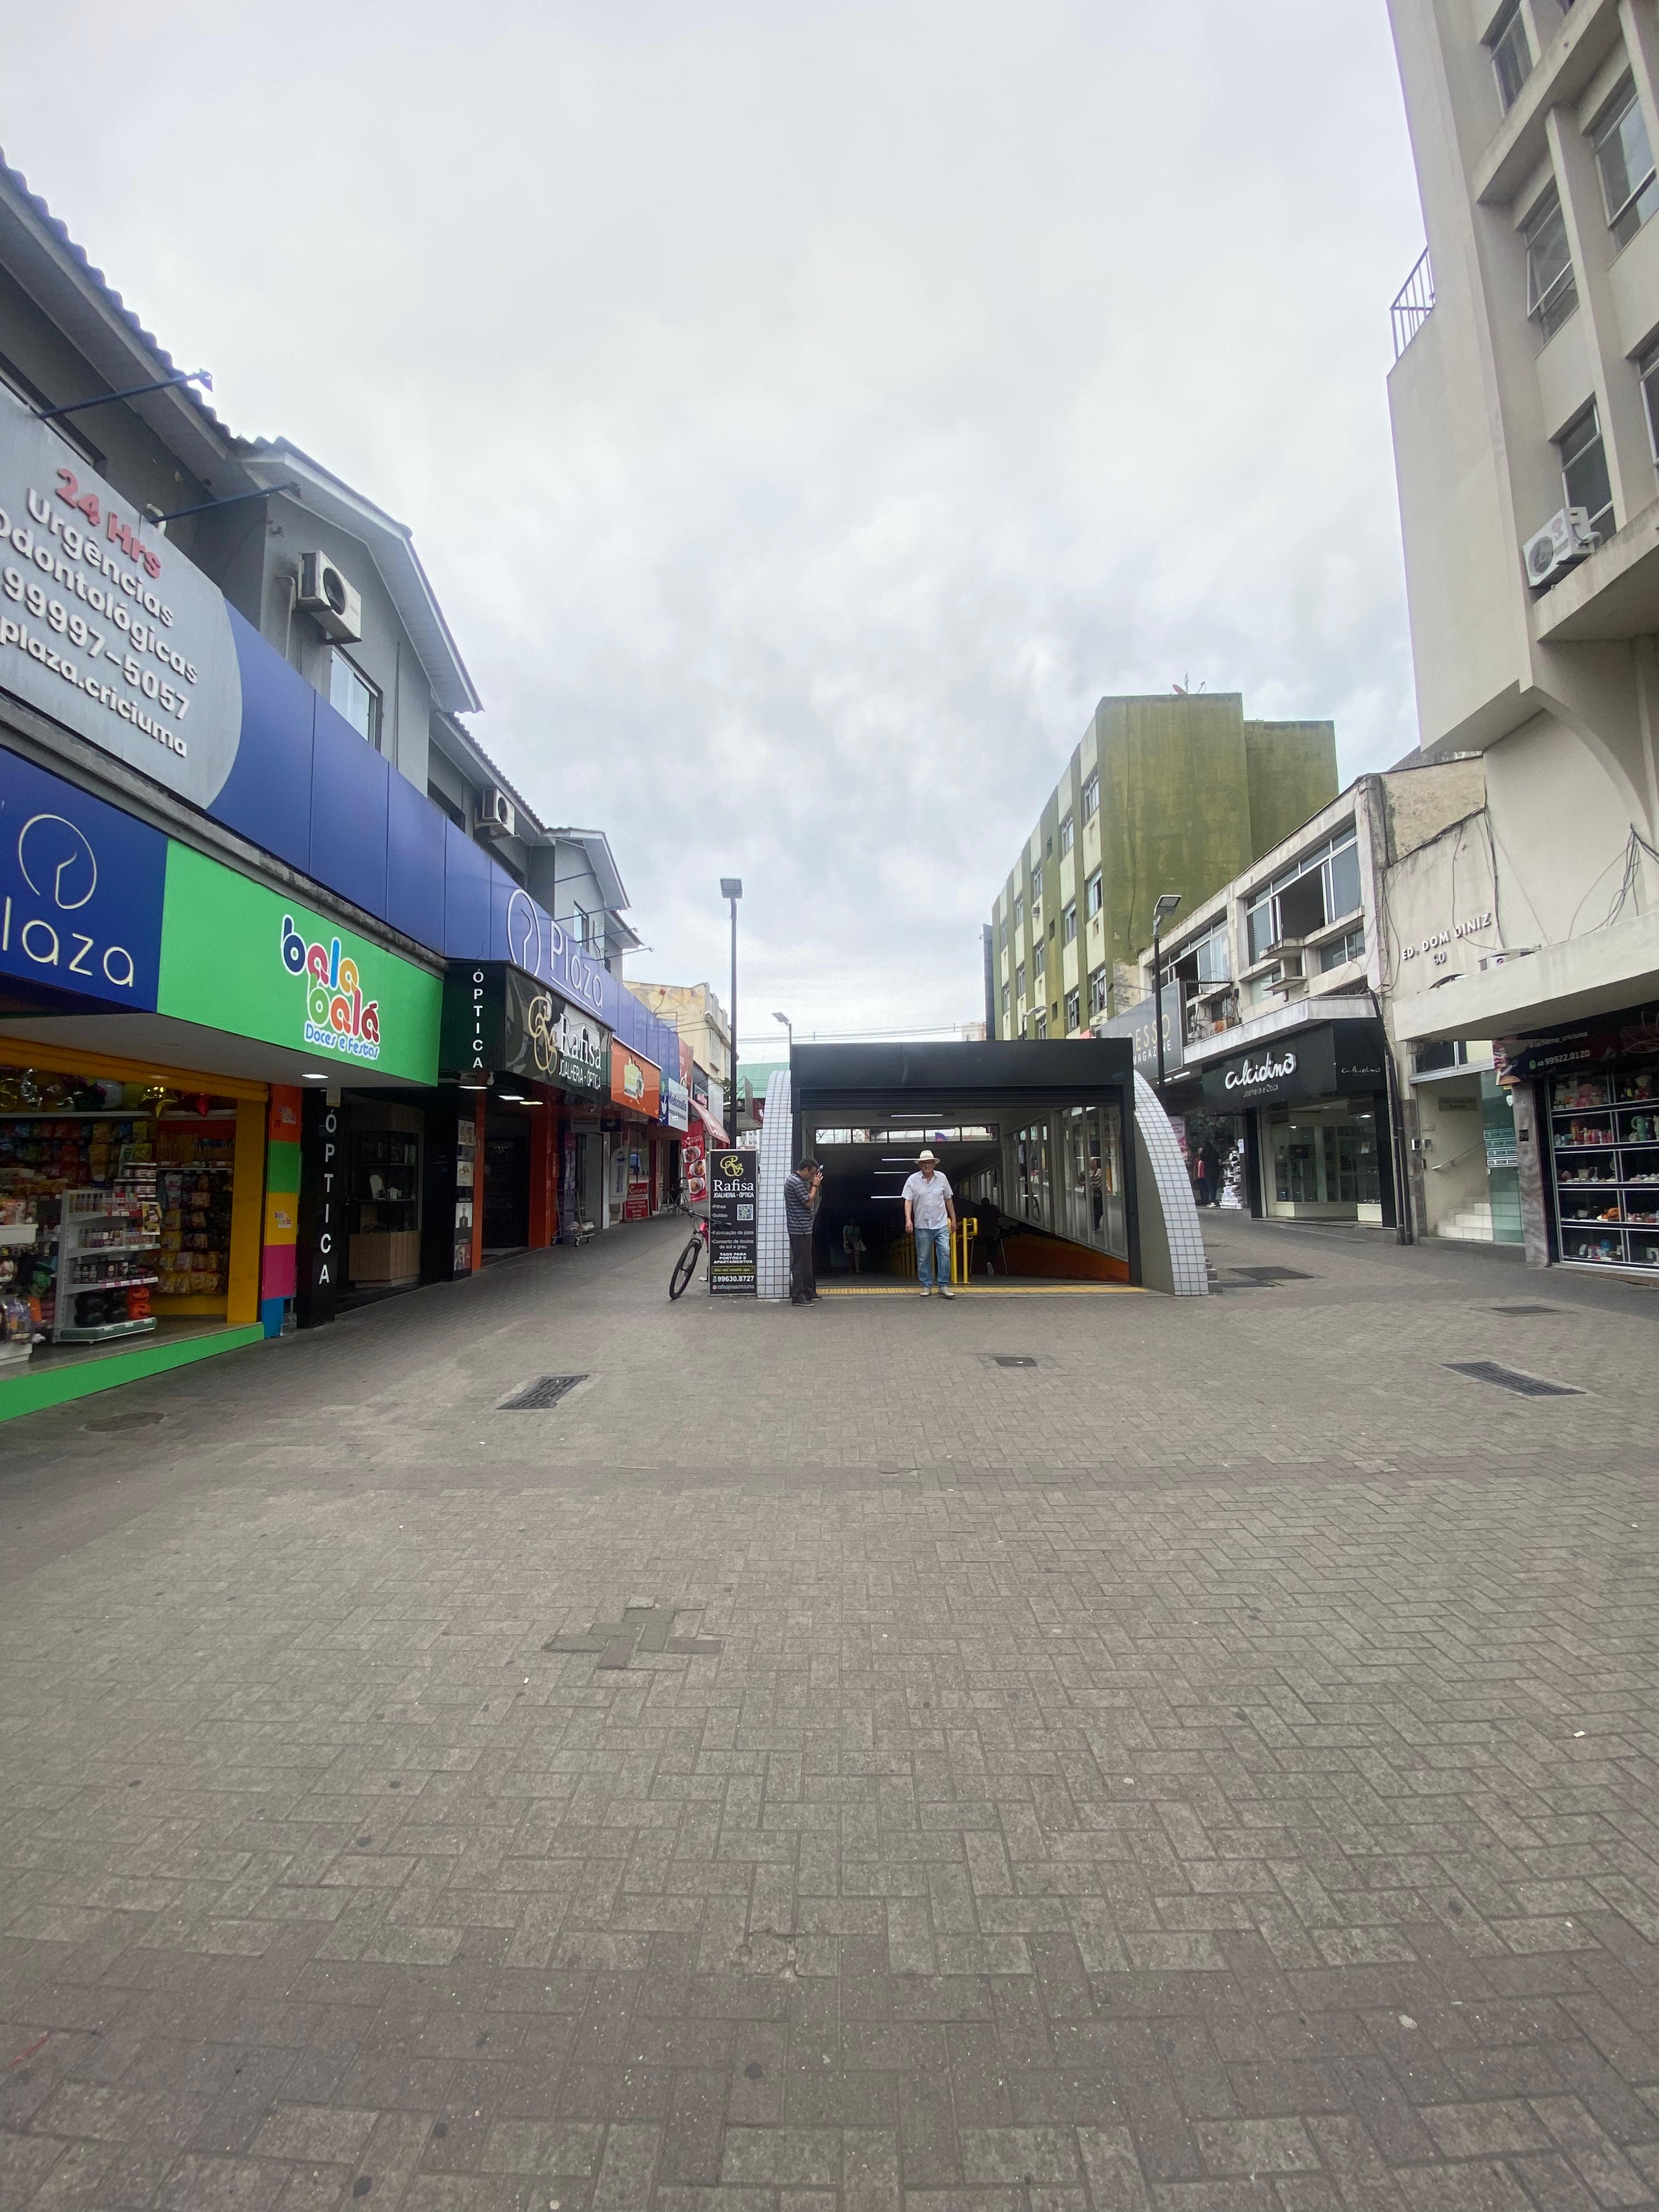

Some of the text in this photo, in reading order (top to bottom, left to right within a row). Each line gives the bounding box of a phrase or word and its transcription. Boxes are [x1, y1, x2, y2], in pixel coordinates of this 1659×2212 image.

[27, 487, 174, 628] Urgências
[55, 469, 161, 578] 24 Hrs
[3, 566, 190, 720] 99997-5057
[281, 914, 359, 996] bala
[550, 921, 602, 1008] Plaza
[1422, 930, 1451, 951] DOM
[1454, 913, 1491, 938] DINIZ
[306, 1023, 336, 1046] Doces
[340, 1037, 346, 1049] e
[473, 968, 484, 1068] ÓPTICA
[560, 1013, 601, 1070] Rafisa
[1133, 1040, 1171, 1065] MAGAZE
[319, 1109, 337, 1284] ÓPTICA
[713, 1179, 754, 1191] Rafisa
